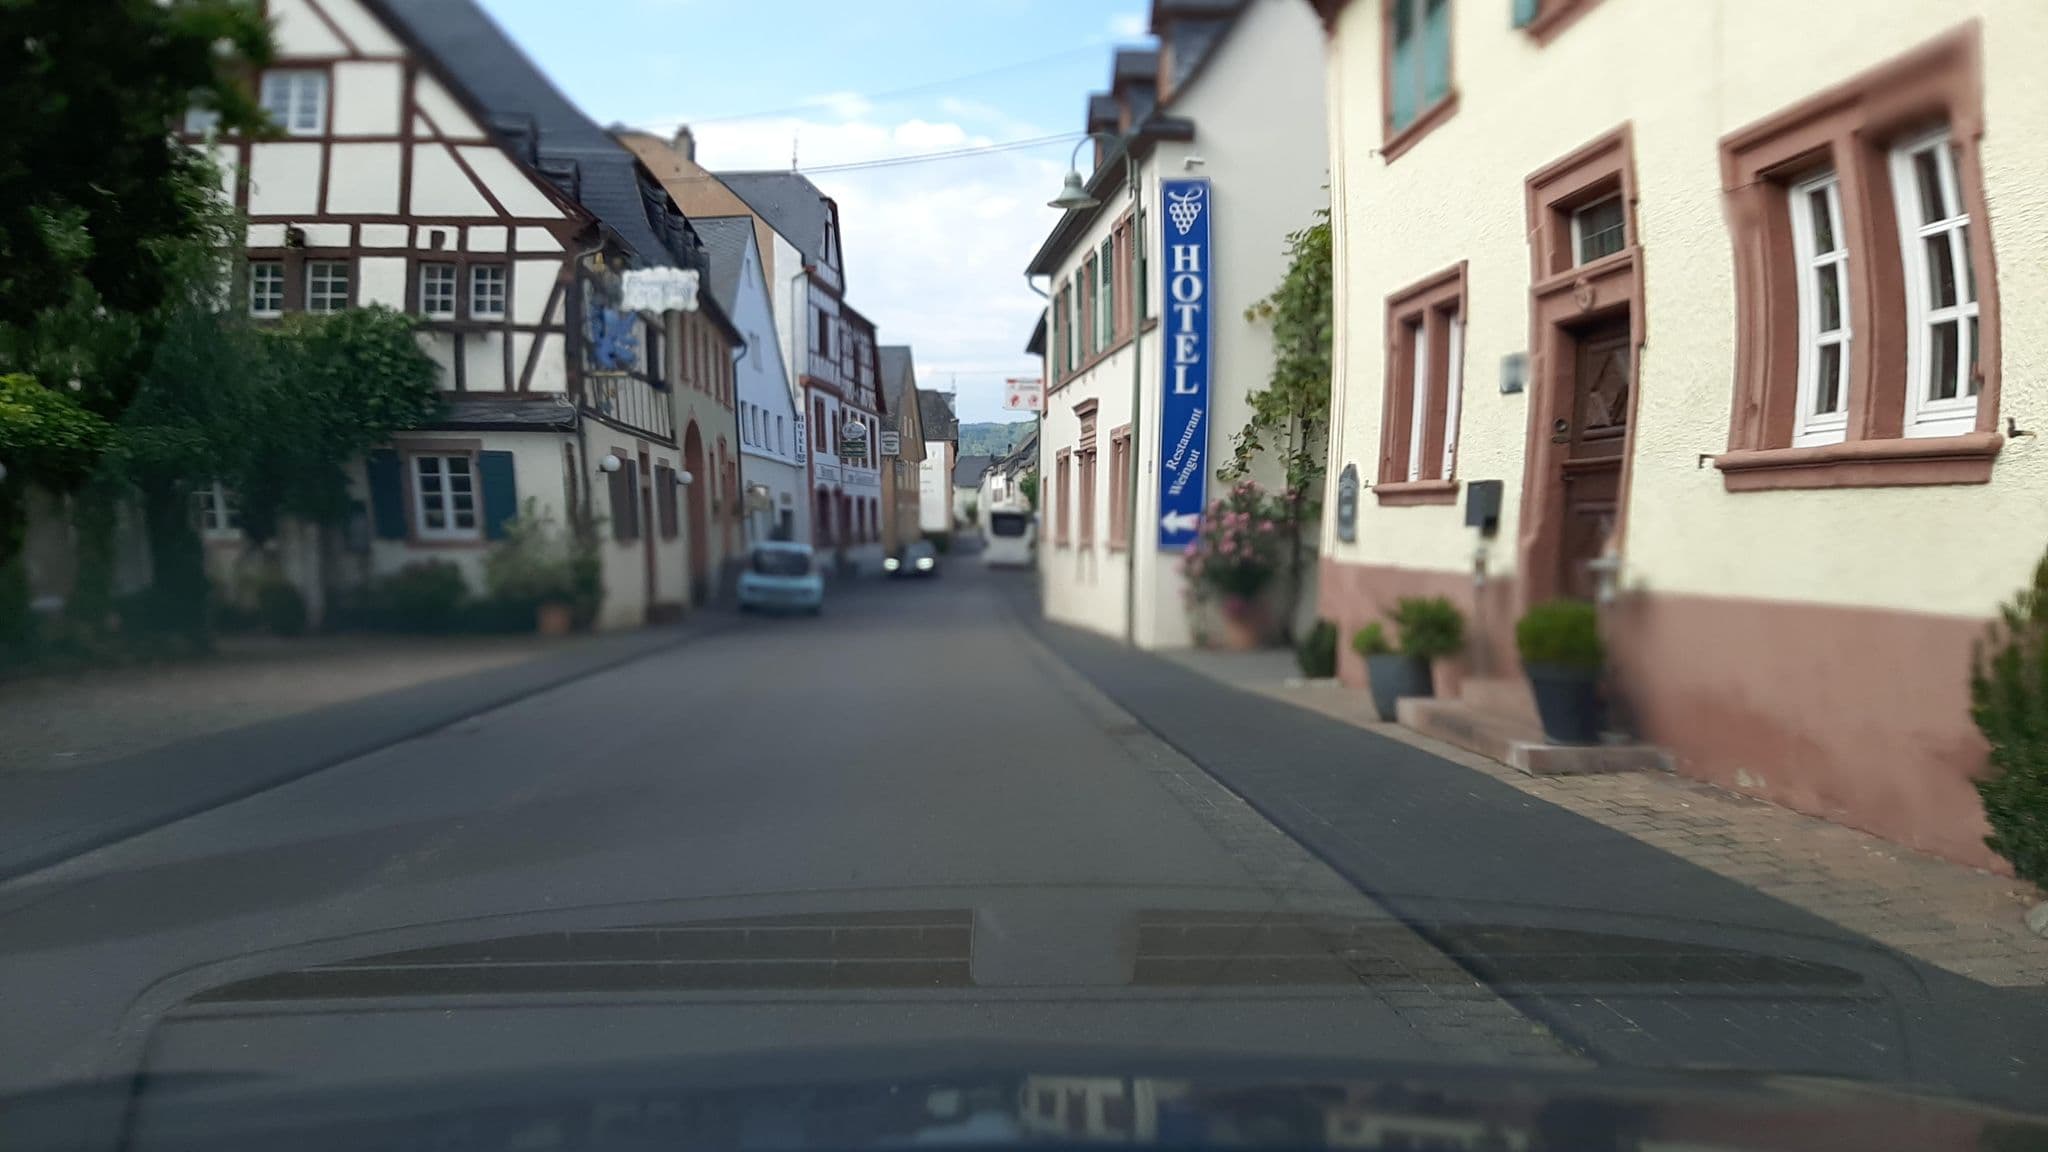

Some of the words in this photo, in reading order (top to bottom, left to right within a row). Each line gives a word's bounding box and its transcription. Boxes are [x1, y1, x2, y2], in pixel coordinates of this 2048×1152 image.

[1171, 244, 1202, 395] HOTEL
[797, 415, 805, 453] HOTEL
[1165, 408, 1203, 471] Restaurant
[1167, 449, 1201, 495] Weingut
